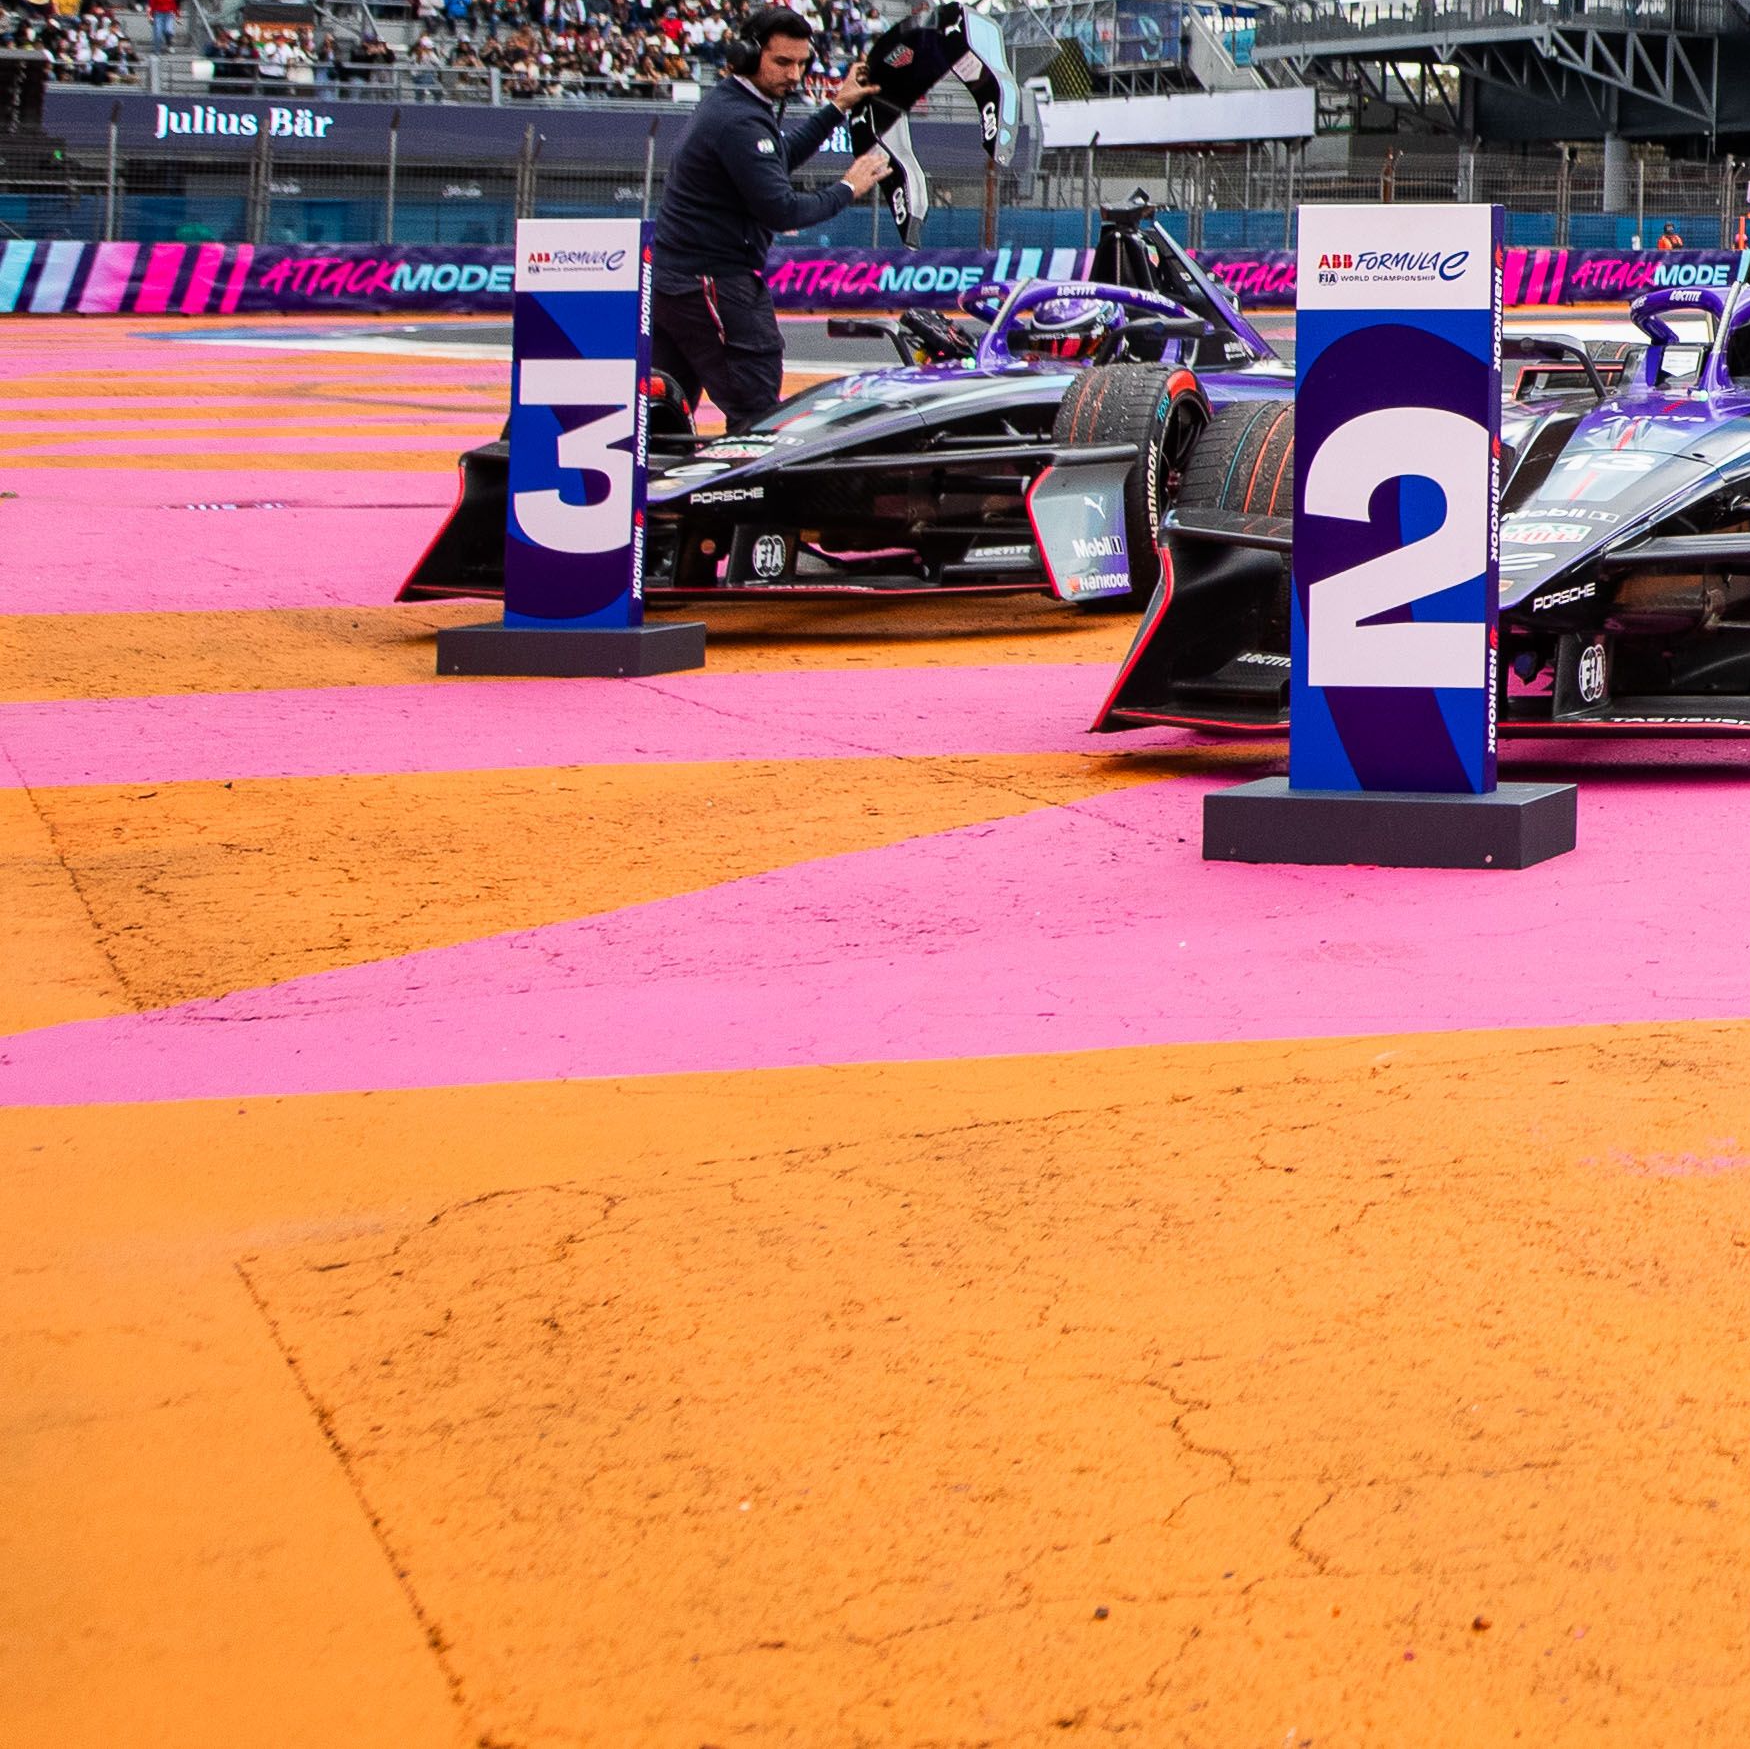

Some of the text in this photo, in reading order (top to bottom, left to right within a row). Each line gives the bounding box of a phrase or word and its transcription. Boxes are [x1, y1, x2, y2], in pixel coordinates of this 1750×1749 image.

[155, 103, 334, 139] Julius Bär
[528, 252, 551, 263] ABB
[551, 250, 606, 265] FORMULA
[1318, 254, 1353, 269] ABB
[1354, 252, 1442, 271] FORMULA
[1318, 272, 1337, 284] FIA
[1372, 274, 1436, 282] CHAMPIONSHIP
[513, 358, 633, 554] 3
[690, 486, 765, 505] PORSCHE
[1072, 537, 1112, 559] Mobil
[1303, 406, 1490, 688] 2
[1533, 582, 1596, 613] PORSCHE
